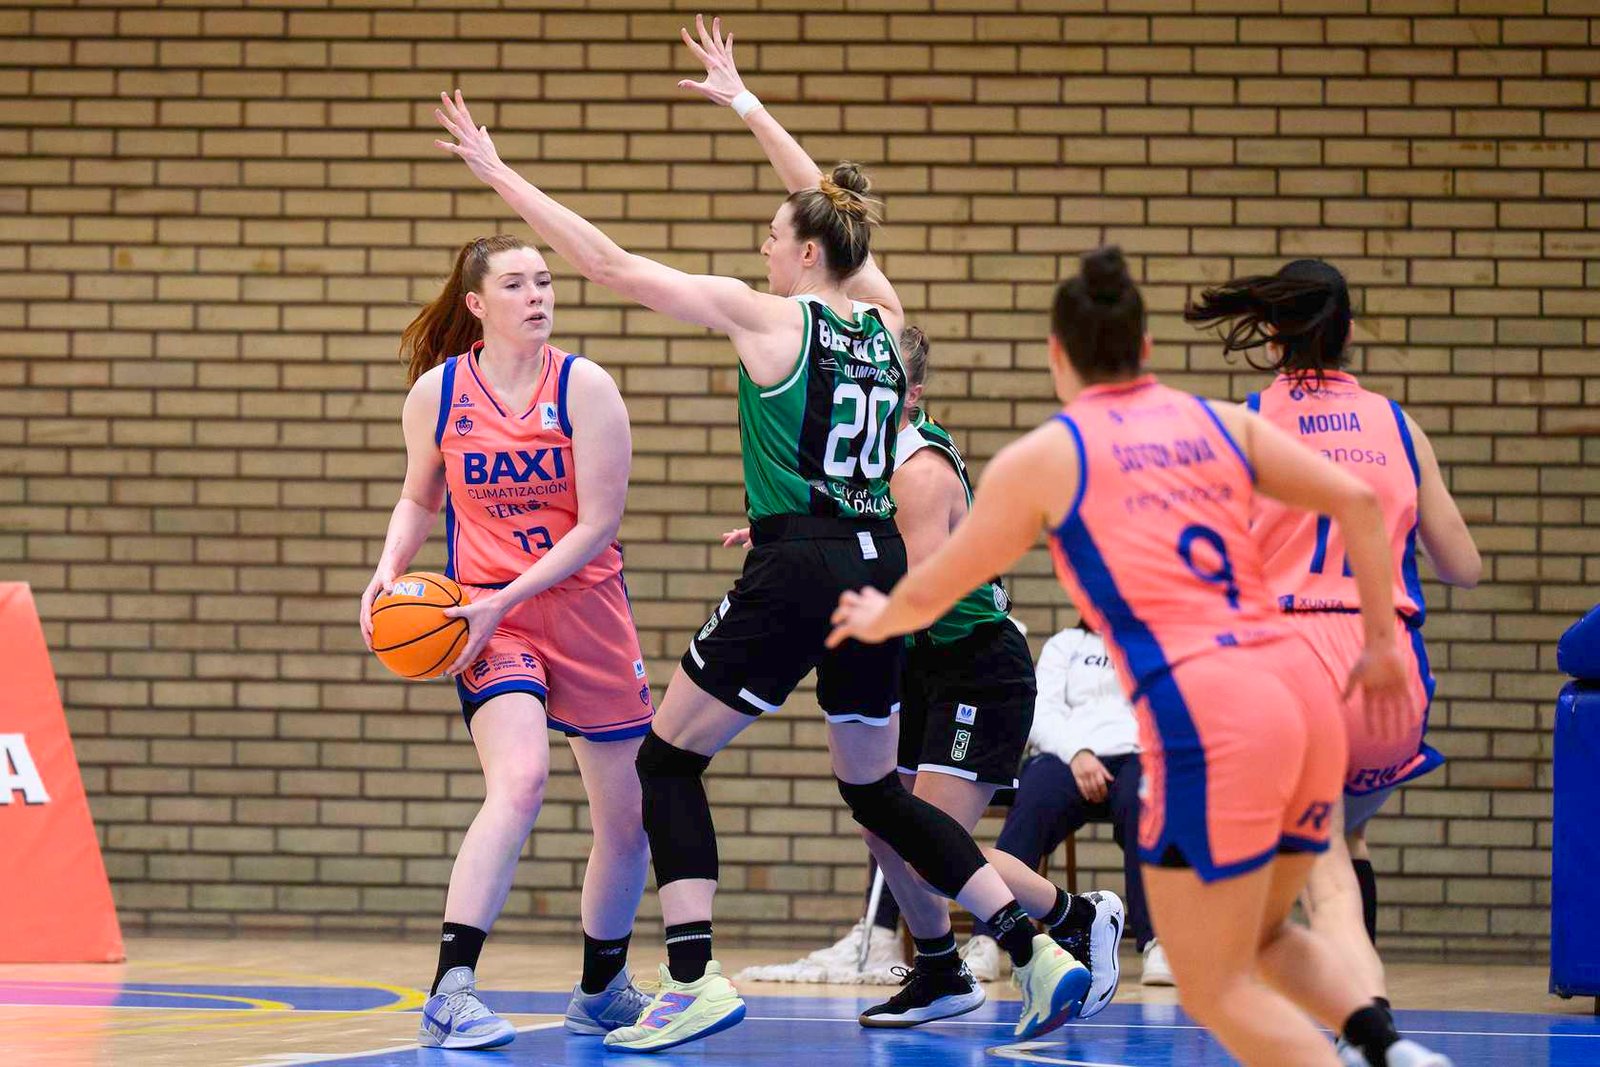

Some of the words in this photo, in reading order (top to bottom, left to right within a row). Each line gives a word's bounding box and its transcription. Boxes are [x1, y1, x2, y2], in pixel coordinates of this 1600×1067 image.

[823, 383, 899, 479] 20
[1298, 412, 1361, 435] MODIA
[463, 446, 566, 485] BAXI
[468, 481, 568, 500] CLIMATIZACIÓN
[1177, 523, 1239, 610] 9
